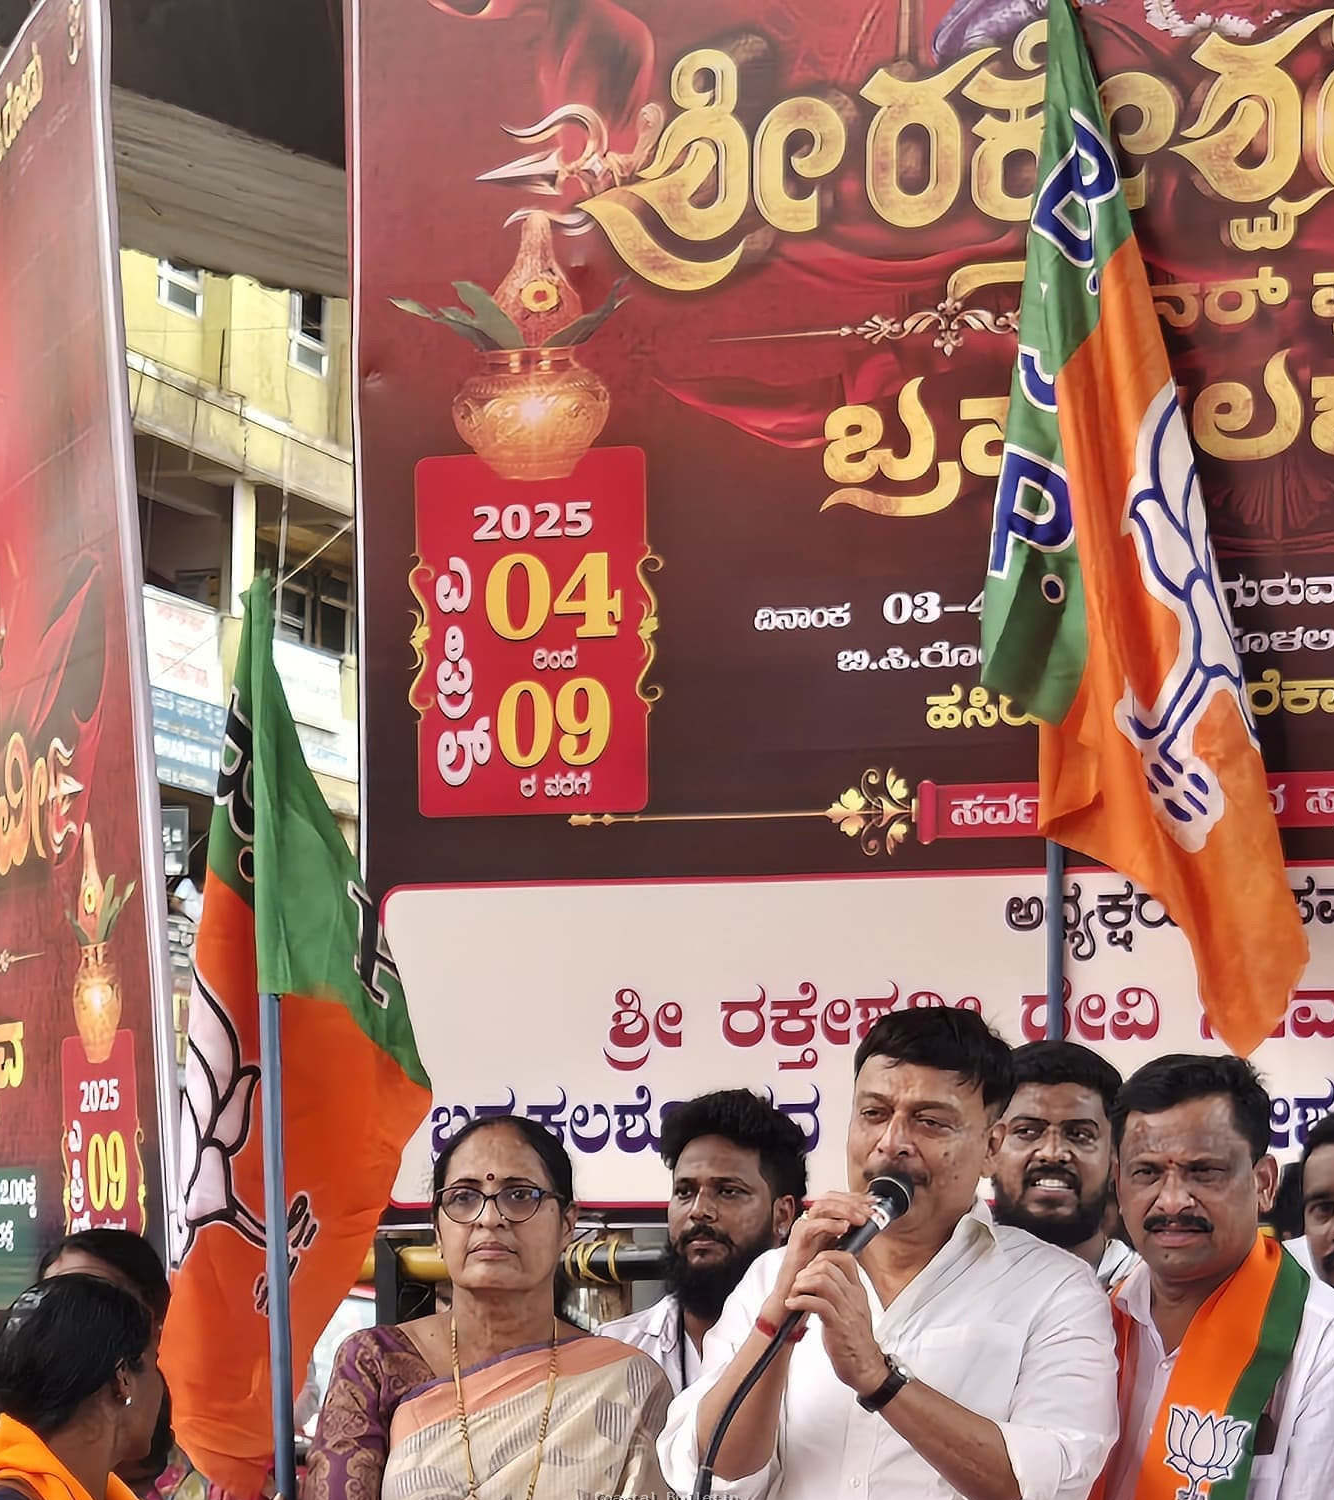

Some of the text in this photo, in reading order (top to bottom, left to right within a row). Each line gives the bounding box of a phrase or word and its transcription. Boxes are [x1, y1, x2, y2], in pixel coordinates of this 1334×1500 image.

[472, 501, 593, 541] 2025
[484, 551, 621, 641] 04
[753, 603, 851, 632] ದಿನಾಂಕ
[496, 676, 611, 769] 09
[602, 985, 684, 1072] ಶ್ರೀ
[78, 1078, 121, 1113] 2025
[87, 1131, 128, 1212] 09
